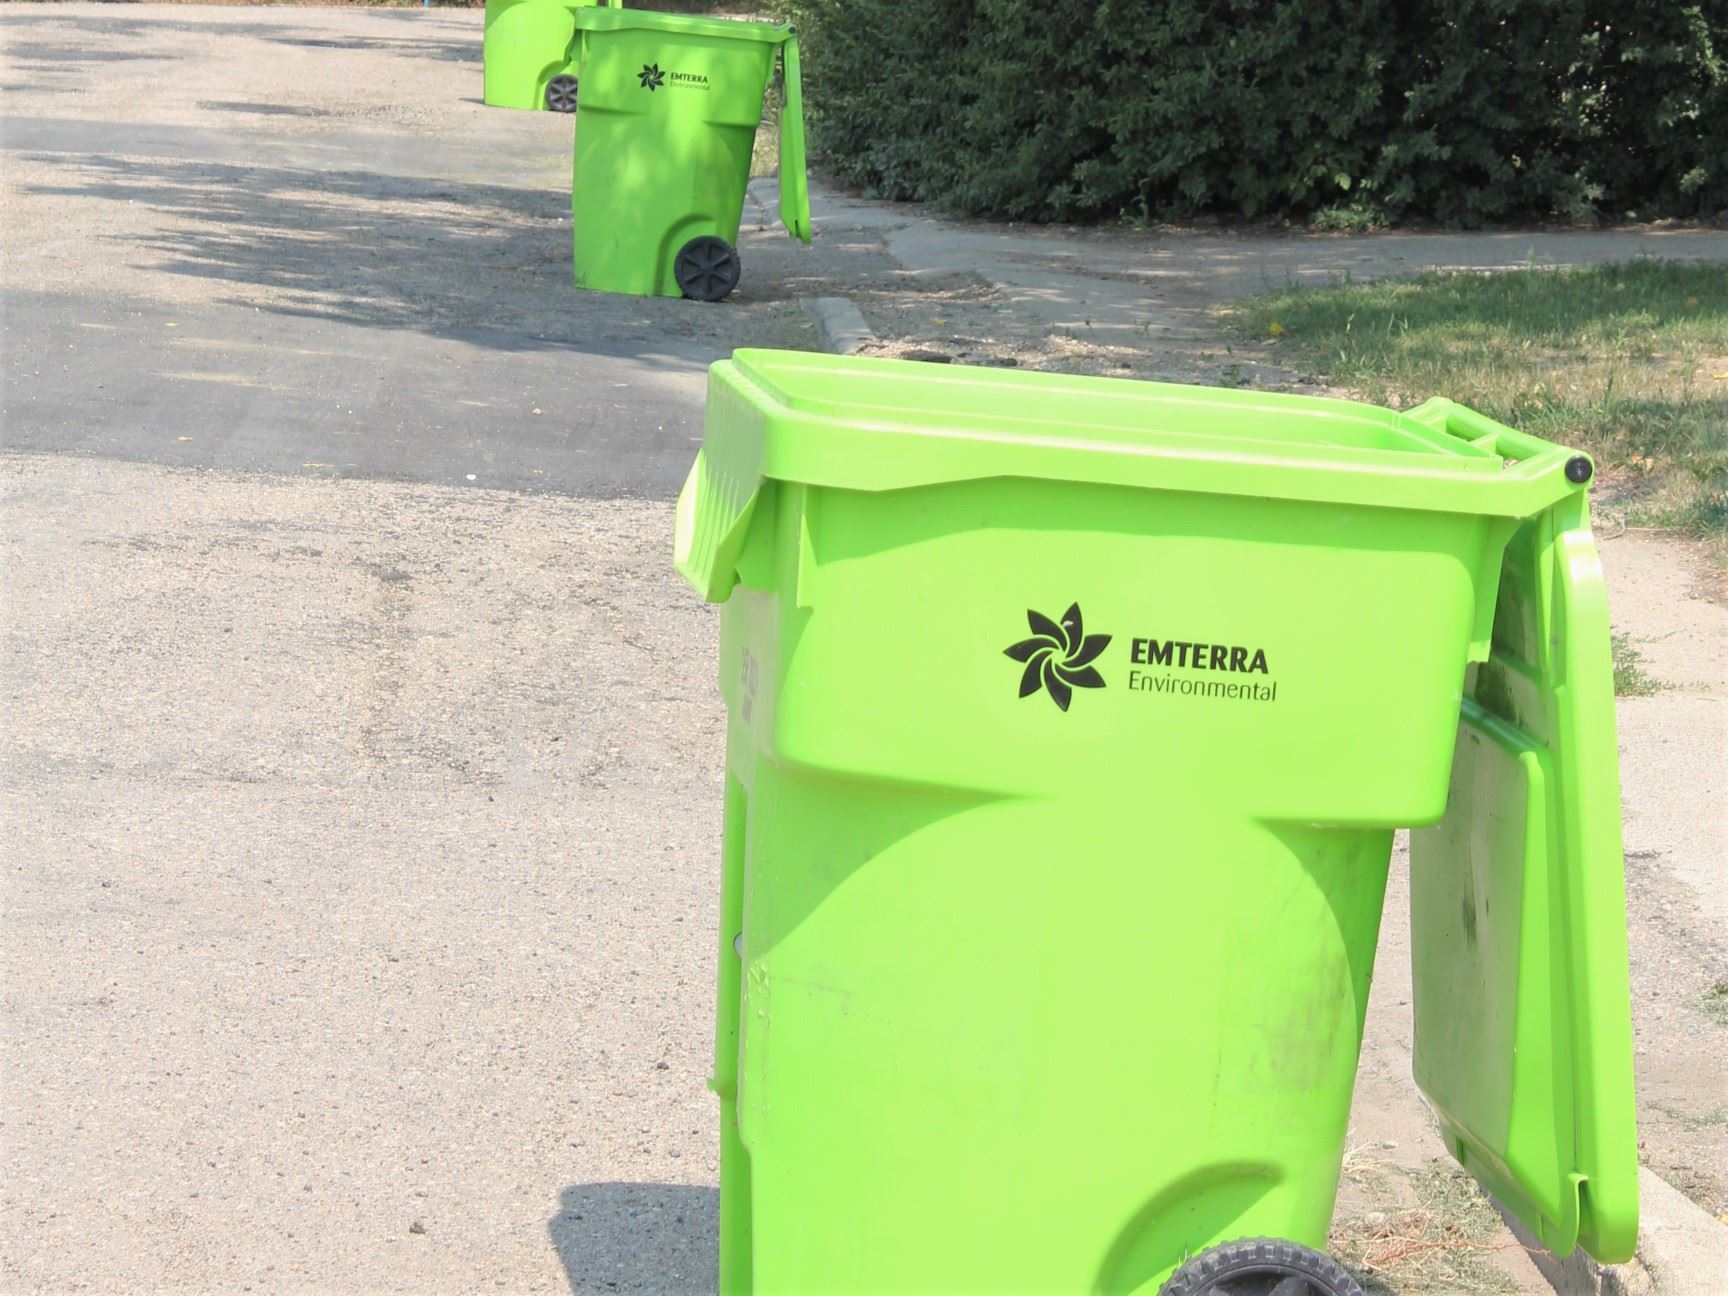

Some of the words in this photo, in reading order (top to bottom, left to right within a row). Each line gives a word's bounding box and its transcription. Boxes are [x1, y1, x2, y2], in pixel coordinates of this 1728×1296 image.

[670, 72, 708, 83] EMTERRA
[1130, 637, 1270, 674] EMTERRA
[1128, 670, 1277, 702] Environmental
